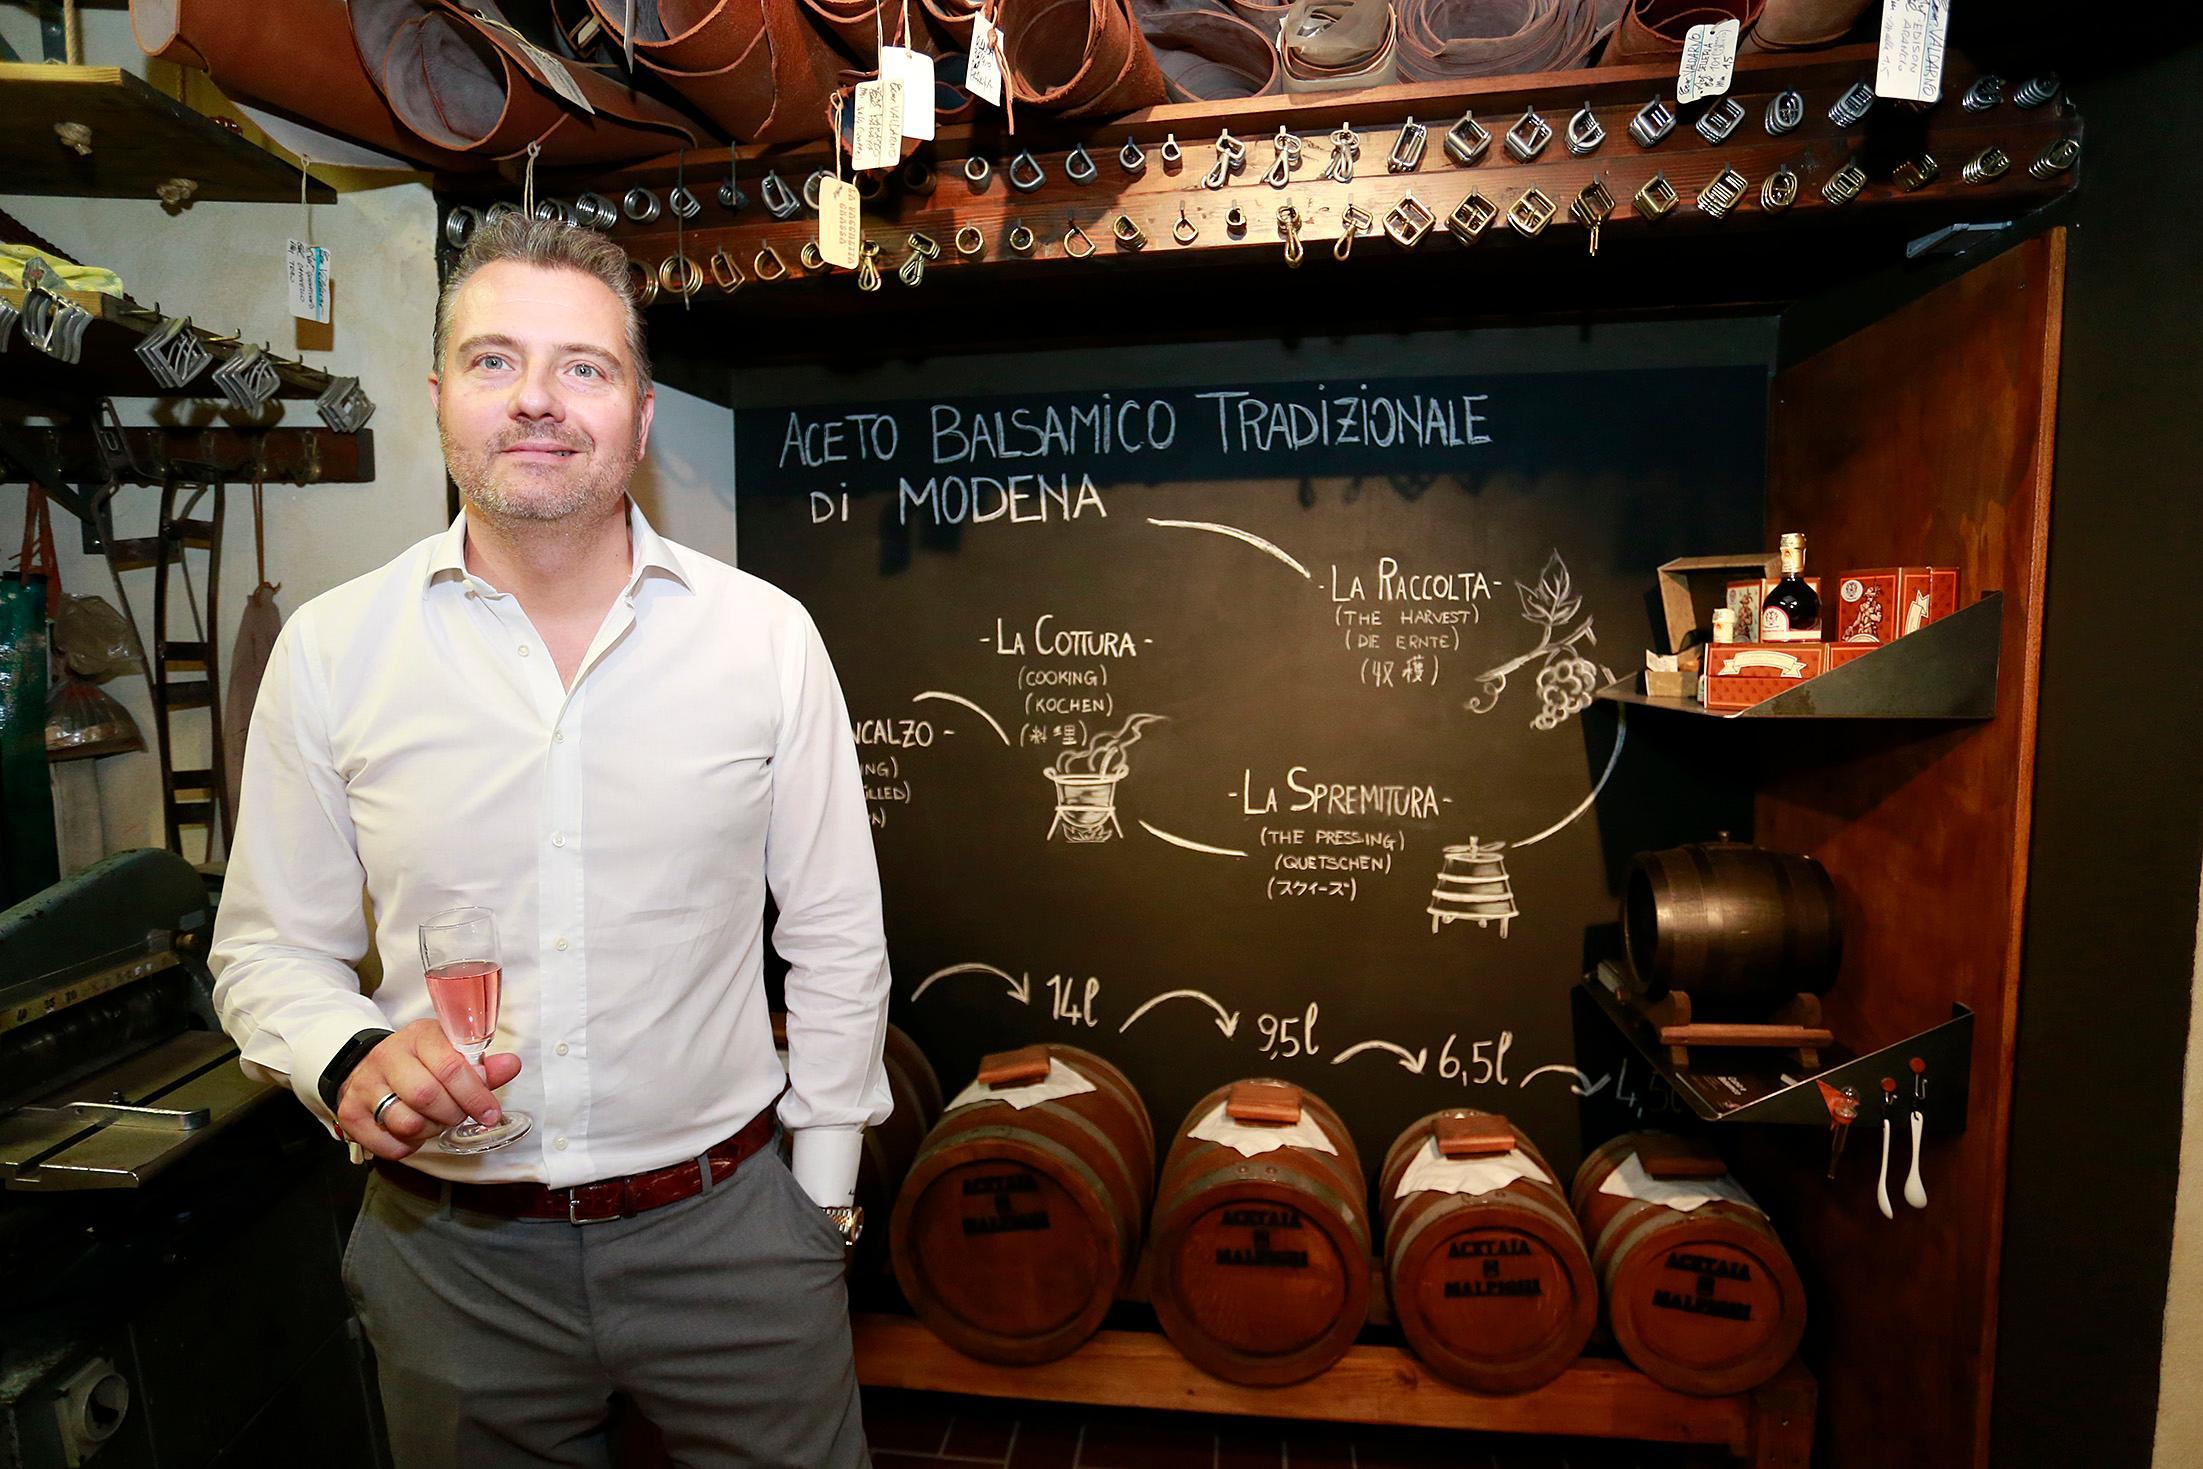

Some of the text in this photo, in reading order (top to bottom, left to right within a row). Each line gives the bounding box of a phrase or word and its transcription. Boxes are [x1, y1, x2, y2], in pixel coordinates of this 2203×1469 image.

[1910, 22, 1922, 73] EDISON
[780, 411, 898, 468] ACETO
[900, 474, 1107, 524] MODENA
[1018, 664, 1107, 690] (COOKING)
[1025, 692, 1114, 716] (KOCHEN)
[1274, 854, 1393, 875] (QUETSCHEN)
